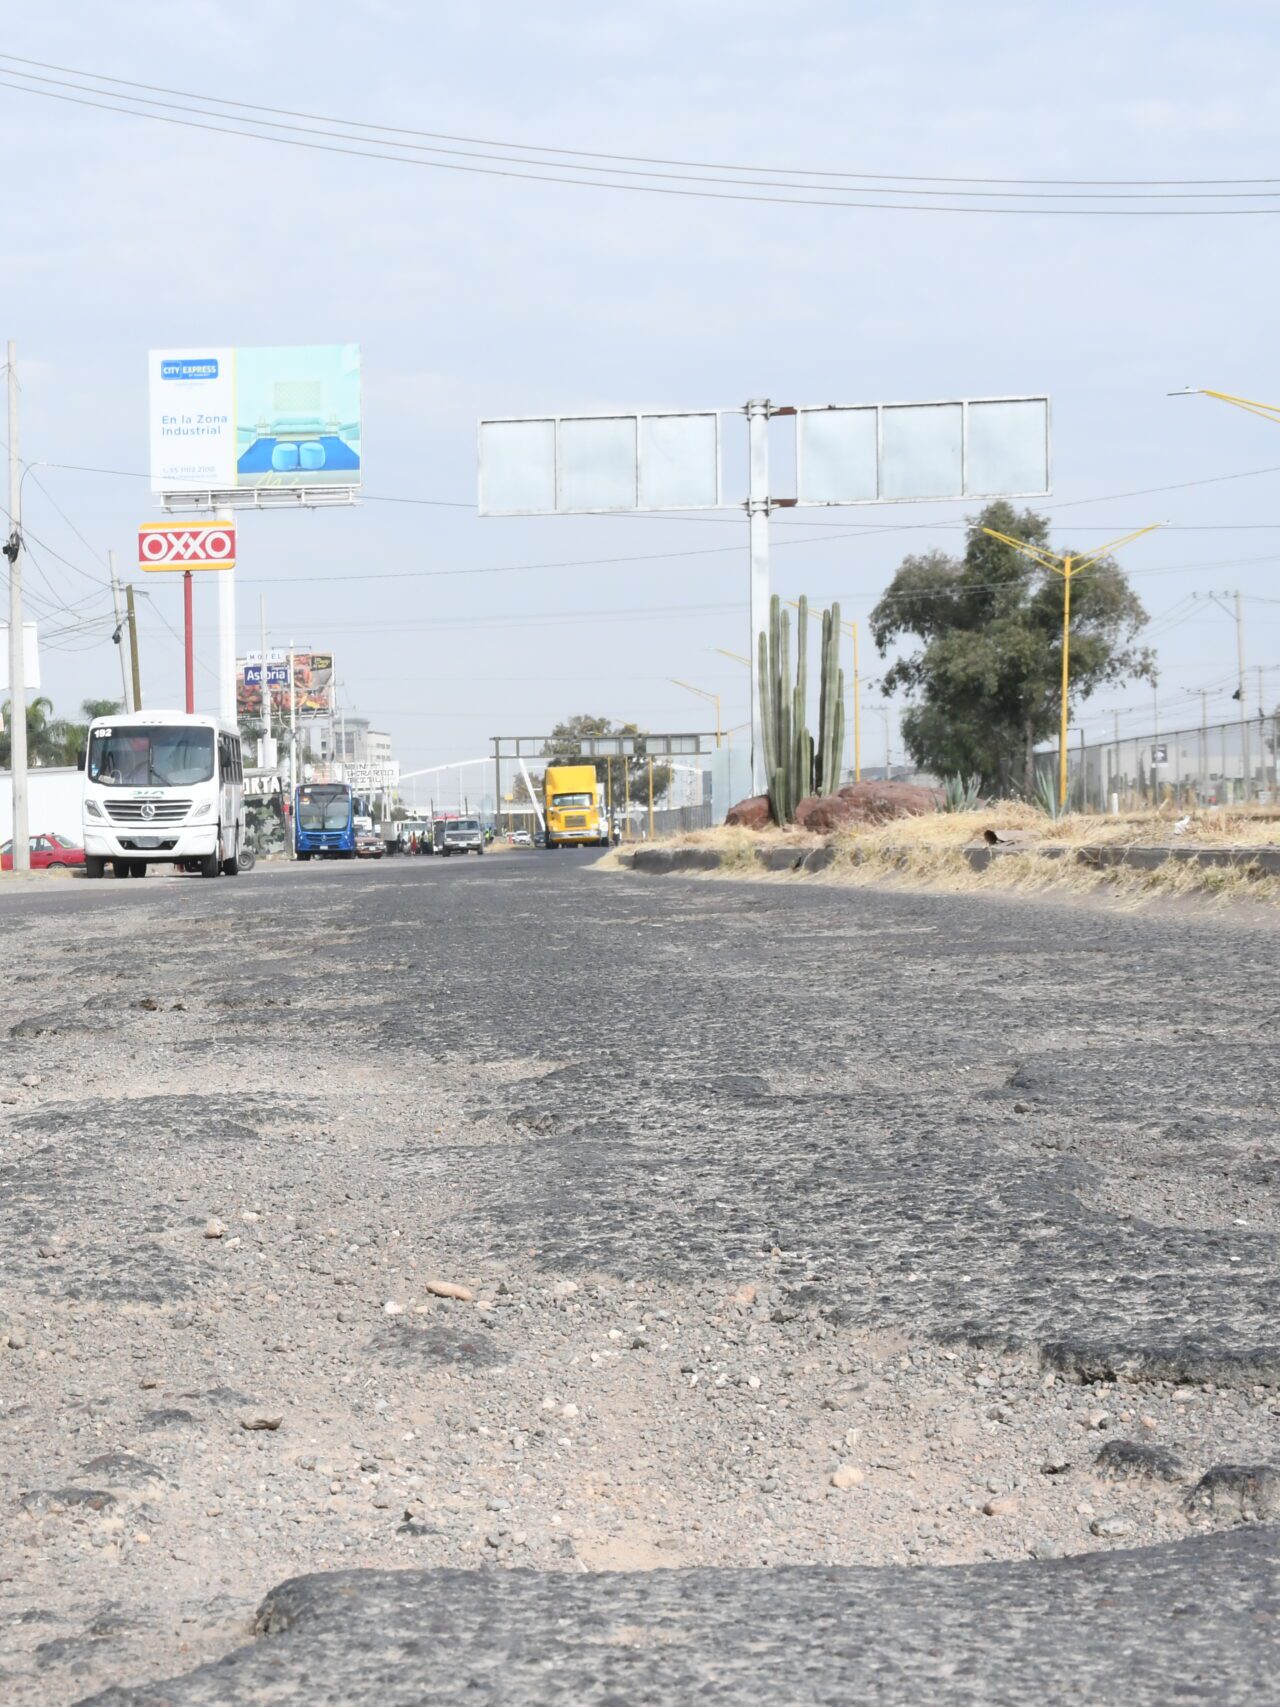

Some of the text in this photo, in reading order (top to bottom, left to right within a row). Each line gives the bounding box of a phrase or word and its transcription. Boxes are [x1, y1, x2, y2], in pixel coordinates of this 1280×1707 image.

[163, 366, 180, 375] CITY
[182, 365, 217, 374] EXPRESS
[161, 414, 228, 425] En la Zona
[161, 425, 221, 436] Industrial
[141, 530, 232, 561] OXXO
[94, 728, 113, 738] 192
